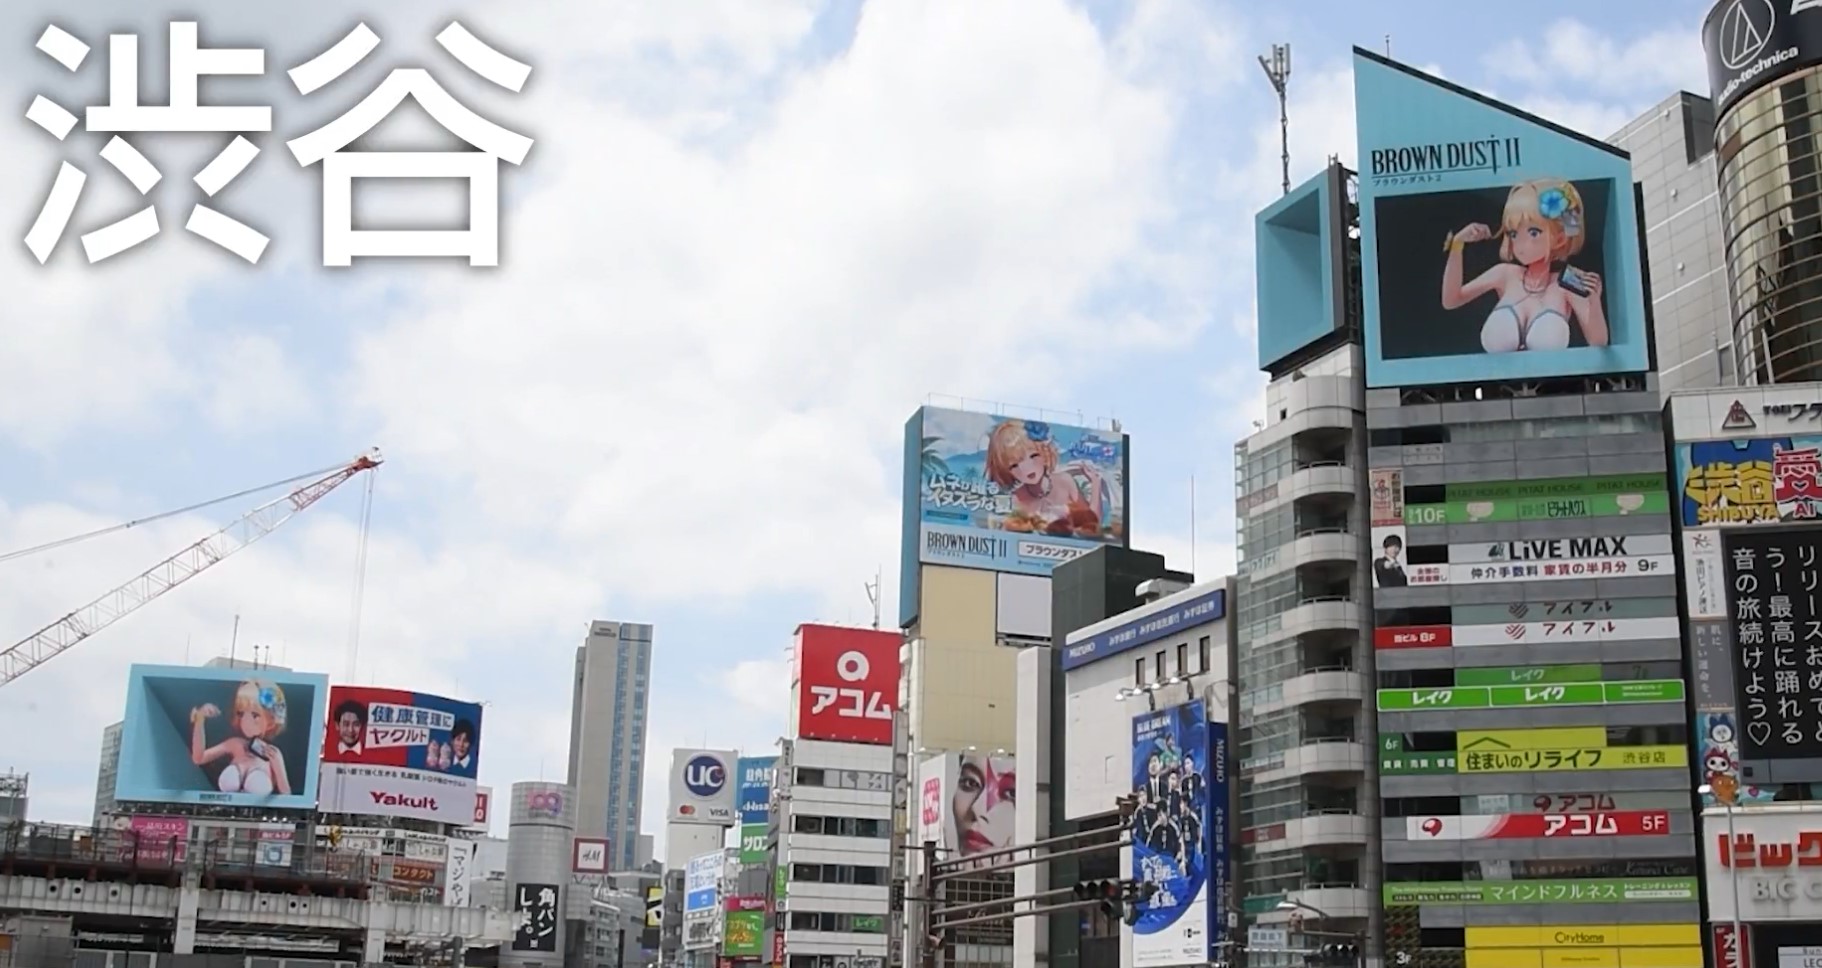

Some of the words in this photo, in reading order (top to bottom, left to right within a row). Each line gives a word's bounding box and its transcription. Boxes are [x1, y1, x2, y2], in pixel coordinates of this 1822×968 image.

[1372, 144, 1443, 175] BROWN
[1446, 134, 1501, 175] DUST
[1416, 507, 1446, 523] 10F
[1698, 504, 1779, 522] SHIBUYA
[1794, 501, 1816, 517] AI
[927, 531, 966, 551] BROWN
[968, 535, 996, 560] DUST
[1026, 544, 1083, 557] ブラウンダス
[1569, 537, 1627, 557] MAX
[1471, 565, 1539, 579] 仲介手数料
[1544, 560, 1628, 576] 家賃の半月分
[1638, 560, 1659, 572] 9F
[1544, 601, 1613, 615] アイフル
[1543, 621, 1616, 636] アイフル
[1511, 669, 1545, 680] レイク
[811, 685, 892, 719] アコム
[1412, 691, 1452, 704] レイク
[1525, 687, 1566, 701] レイク
[371, 705, 453, 727] 健康管理に
[369, 728, 427, 744] ヤクルト
[1385, 738, 1399, 750] 6F
[1466, 750, 1602, 770] 住まいのリライフ
[1623, 752, 1666, 764] 渋谷店
[687, 765, 724, 787] UC
[370, 792, 438, 811] Yakult
[1558, 795, 1616, 812] アコム
[710, 808, 729, 817] VISA
[1543, 814, 1618, 836] アコム
[1642, 815, 1665, 831] 5F
[394, 867, 434, 879] コンタクト
[1491, 883, 1618, 900] マインドフルネス
[1754, 880, 1798, 900] BIC
[1396, 951, 1412, 964] 3F
